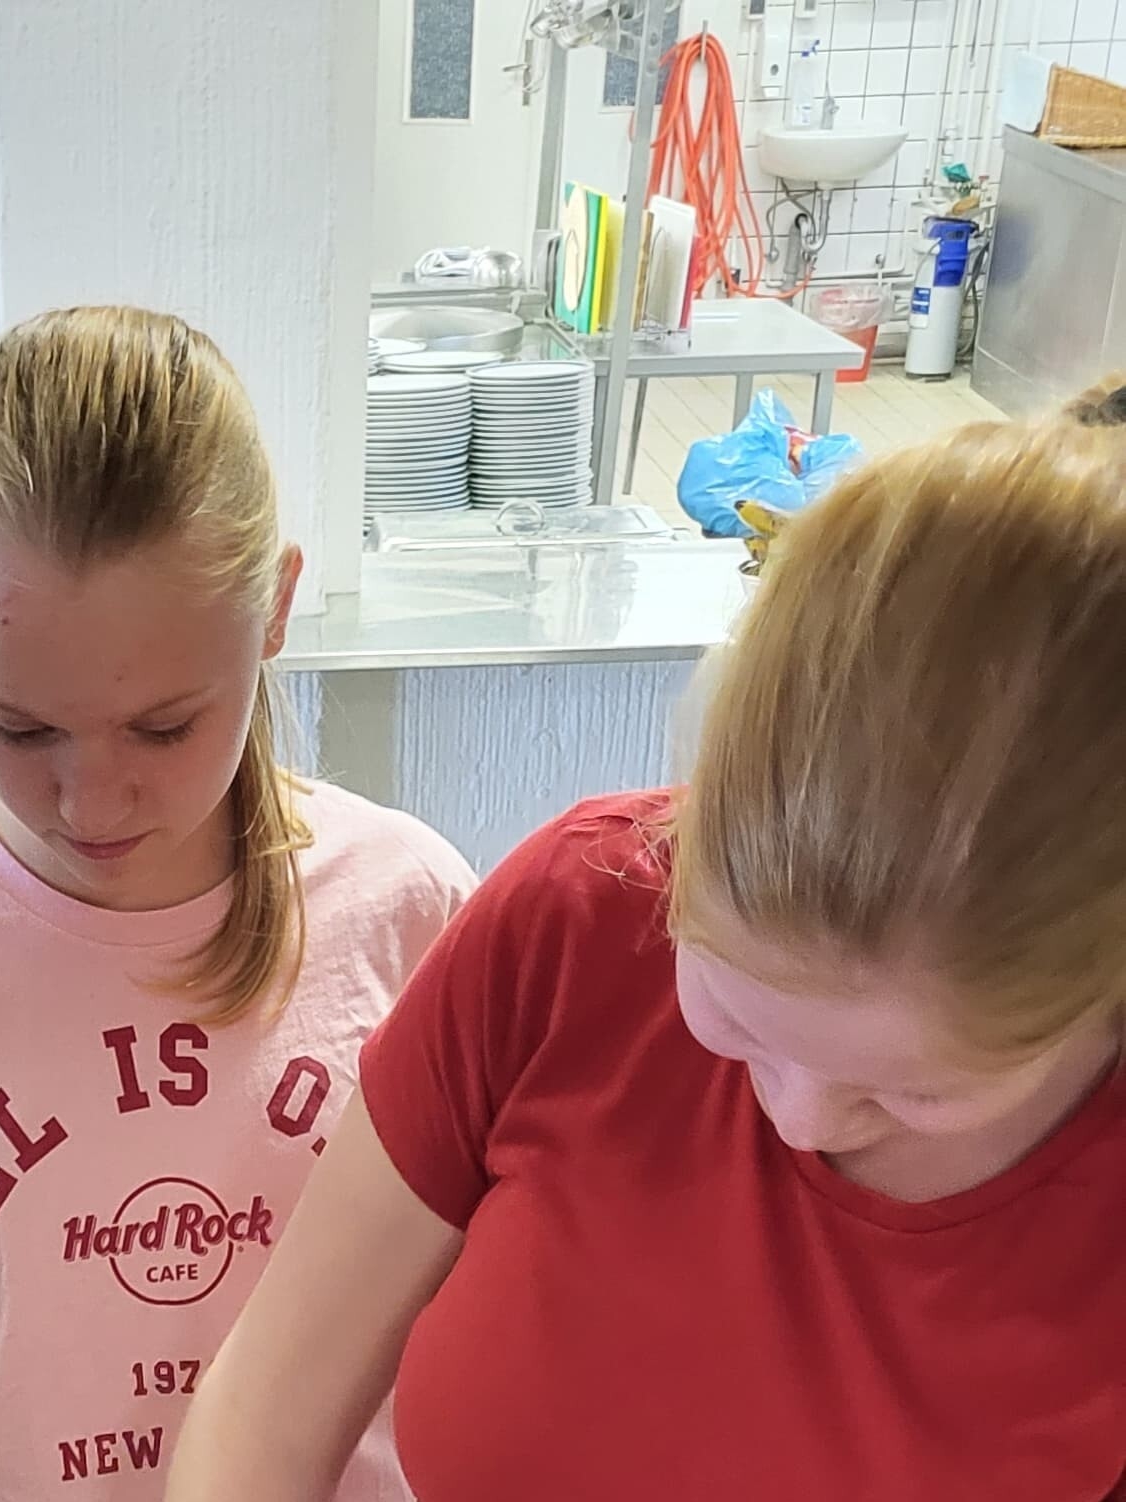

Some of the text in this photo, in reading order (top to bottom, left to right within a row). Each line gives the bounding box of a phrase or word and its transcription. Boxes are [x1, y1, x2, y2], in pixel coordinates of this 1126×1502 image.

[102, 1022, 210, 1114] IS
[62, 1195, 273, 1262] Hard Rock
[145, 1263, 200, 1284] CAFE
[58, 1427, 164, 1481] NEW
